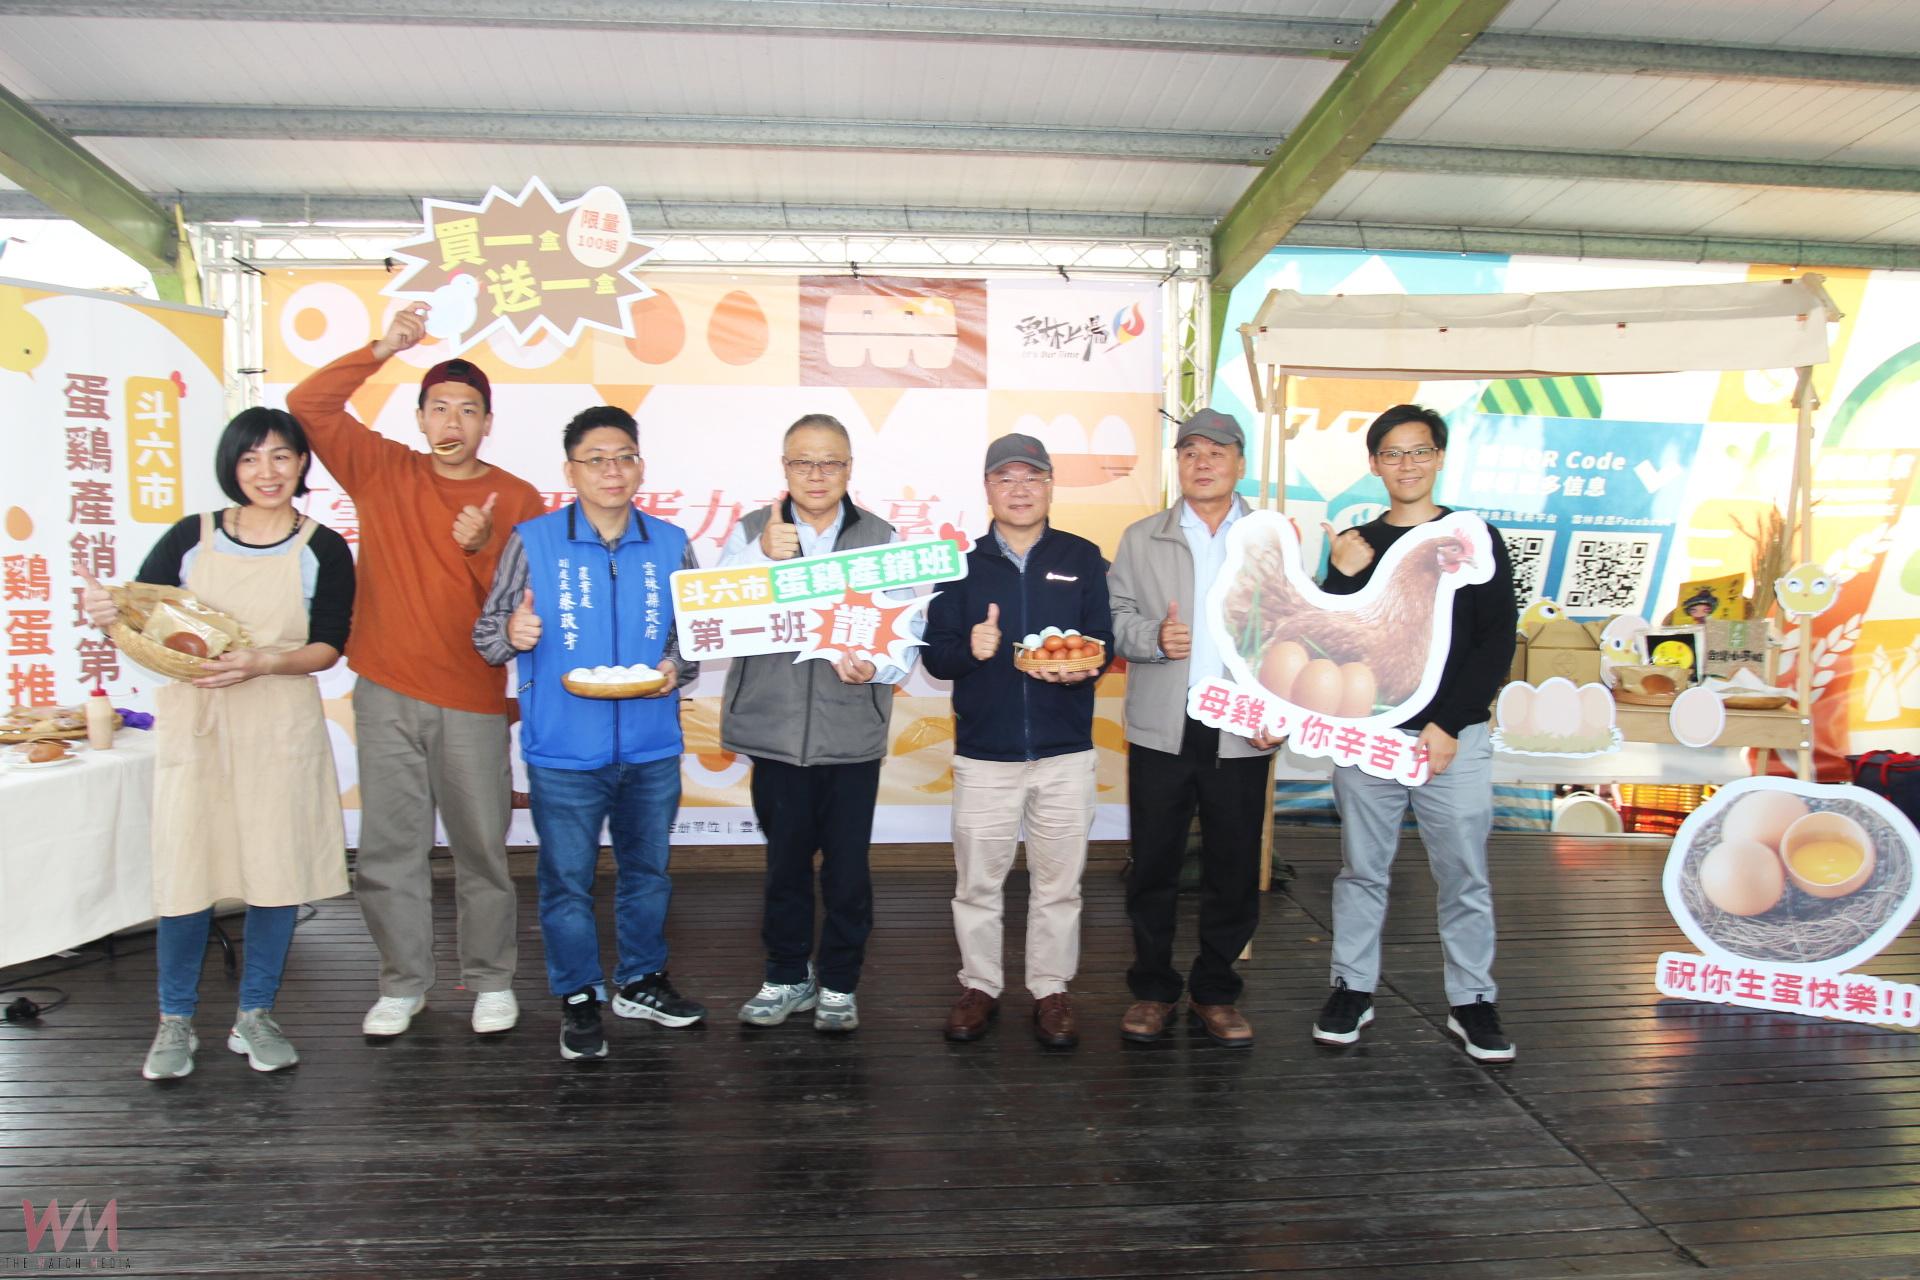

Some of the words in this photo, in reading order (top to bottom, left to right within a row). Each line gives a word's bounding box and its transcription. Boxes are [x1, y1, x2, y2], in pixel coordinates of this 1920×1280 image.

[581, 209, 620, 234] 限量
[435, 217, 562, 272] 買一盒
[577, 234, 619, 254] 100組
[485, 260, 617, 316] 送一盒
[132, 388, 177, 511] 斗六市
[1565, 451, 1627, 470] Code
[681, 574, 769, 606] 斗六市
[689, 610, 808, 652] 第一班
